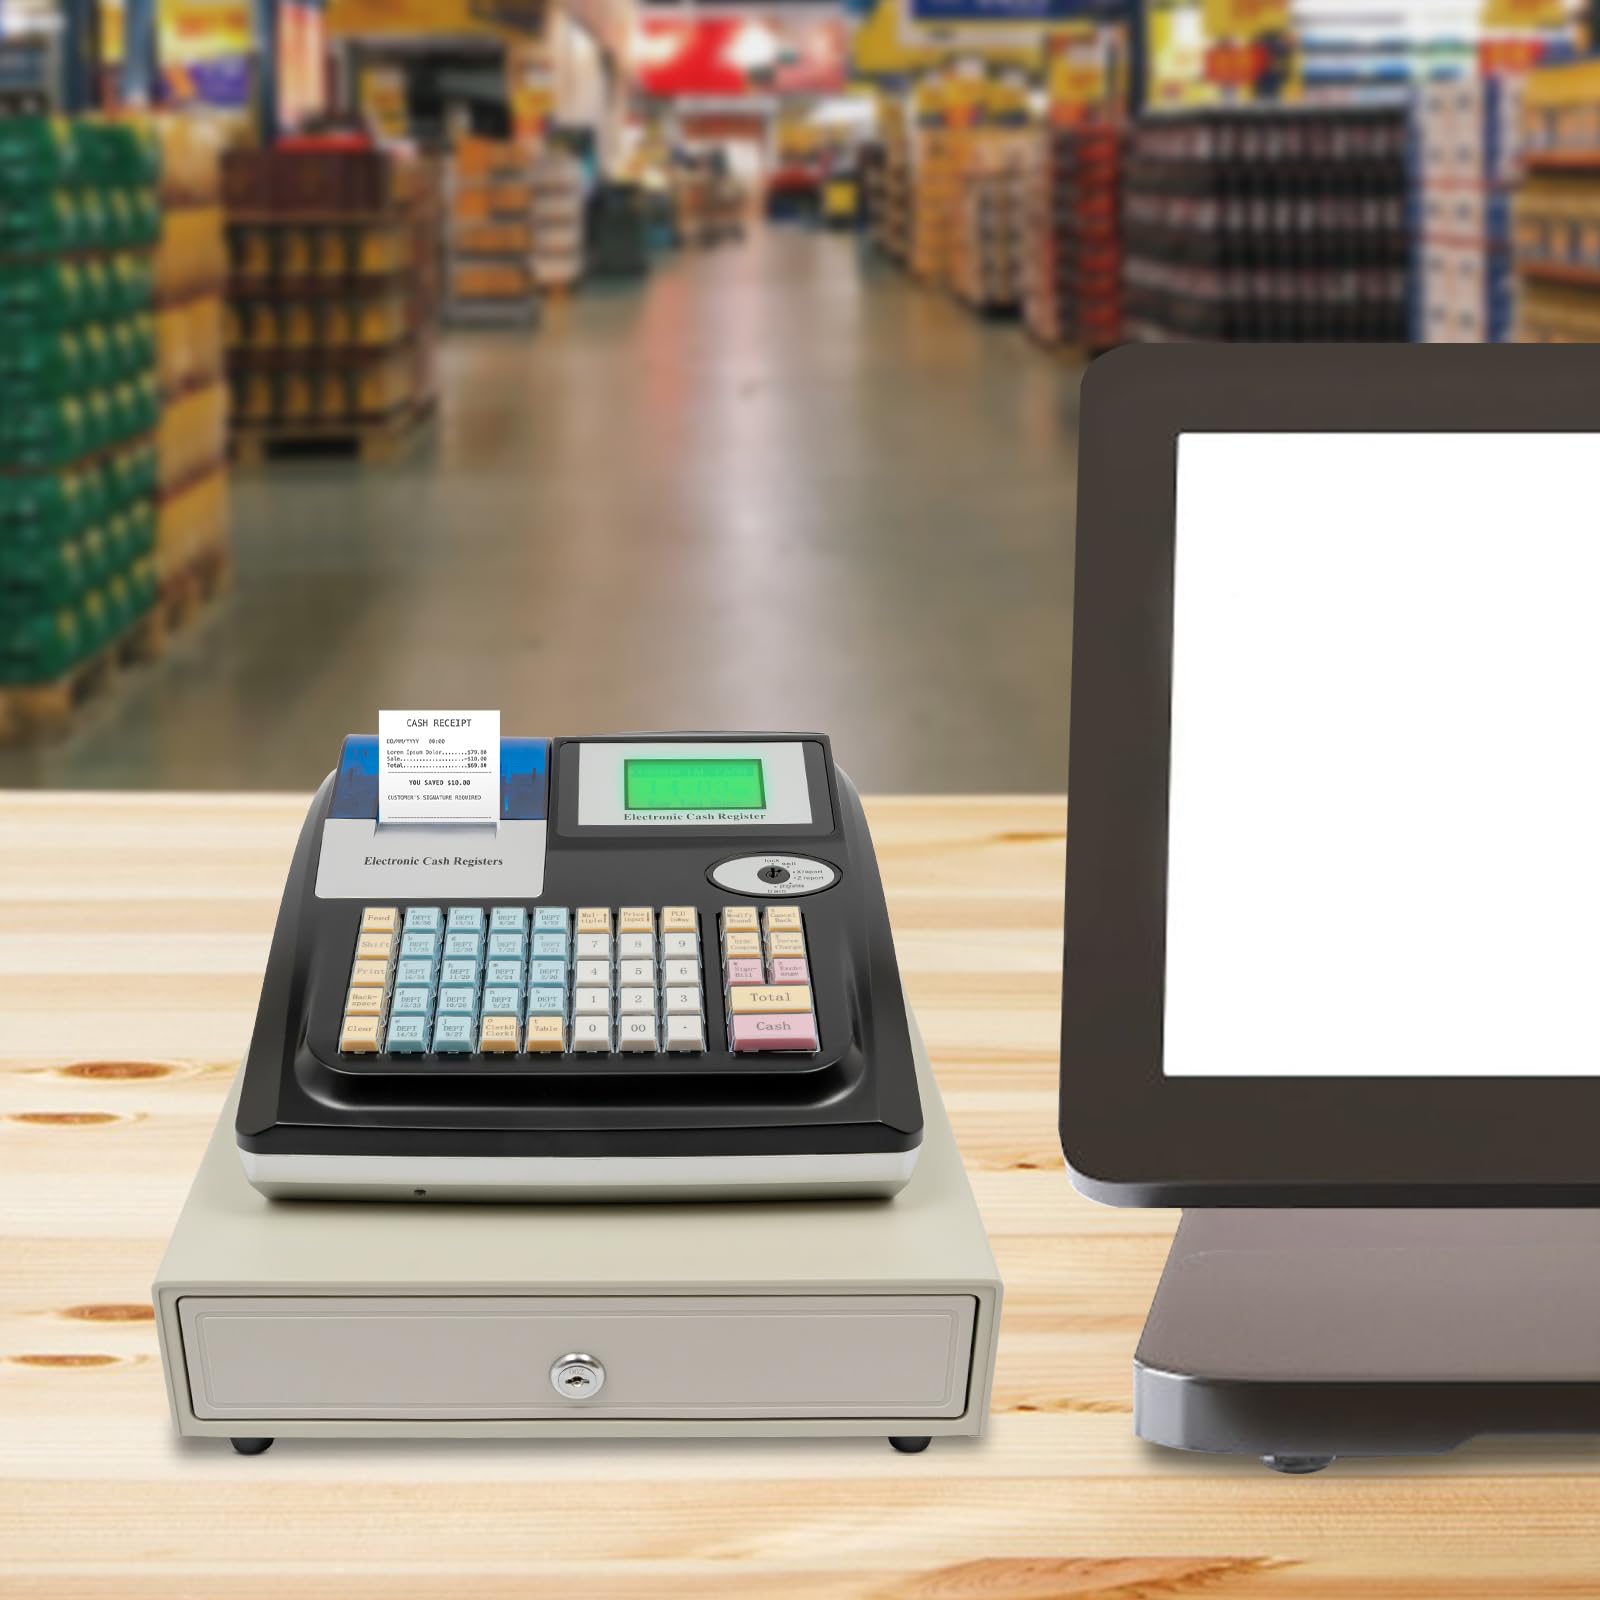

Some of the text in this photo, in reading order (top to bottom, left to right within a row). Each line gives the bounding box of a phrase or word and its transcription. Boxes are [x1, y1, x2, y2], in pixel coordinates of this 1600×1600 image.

[406, 718, 472, 728] CASH RECEIPT
[623, 812, 766, 822] Electronic Cash Register
[363, 856, 503, 868] Electronic Cash Registers
[591, 940, 598, 948] 7
[634, 940, 642, 948] 8
[678, 940, 686, 948] 9
[591, 967, 597, 976] 4
[635, 967, 642, 975] 5
[680, 967, 688, 975] 6
[591, 995, 596, 1004] 1
[634, 995, 643, 1003] 2
[680, 994, 688, 1003] 3
[749, 991, 792, 1002] Total
[588, 1023, 597, 1033] 0
[630, 1023, 647, 1033] 00
[756, 1021, 792, 1031] Cash
